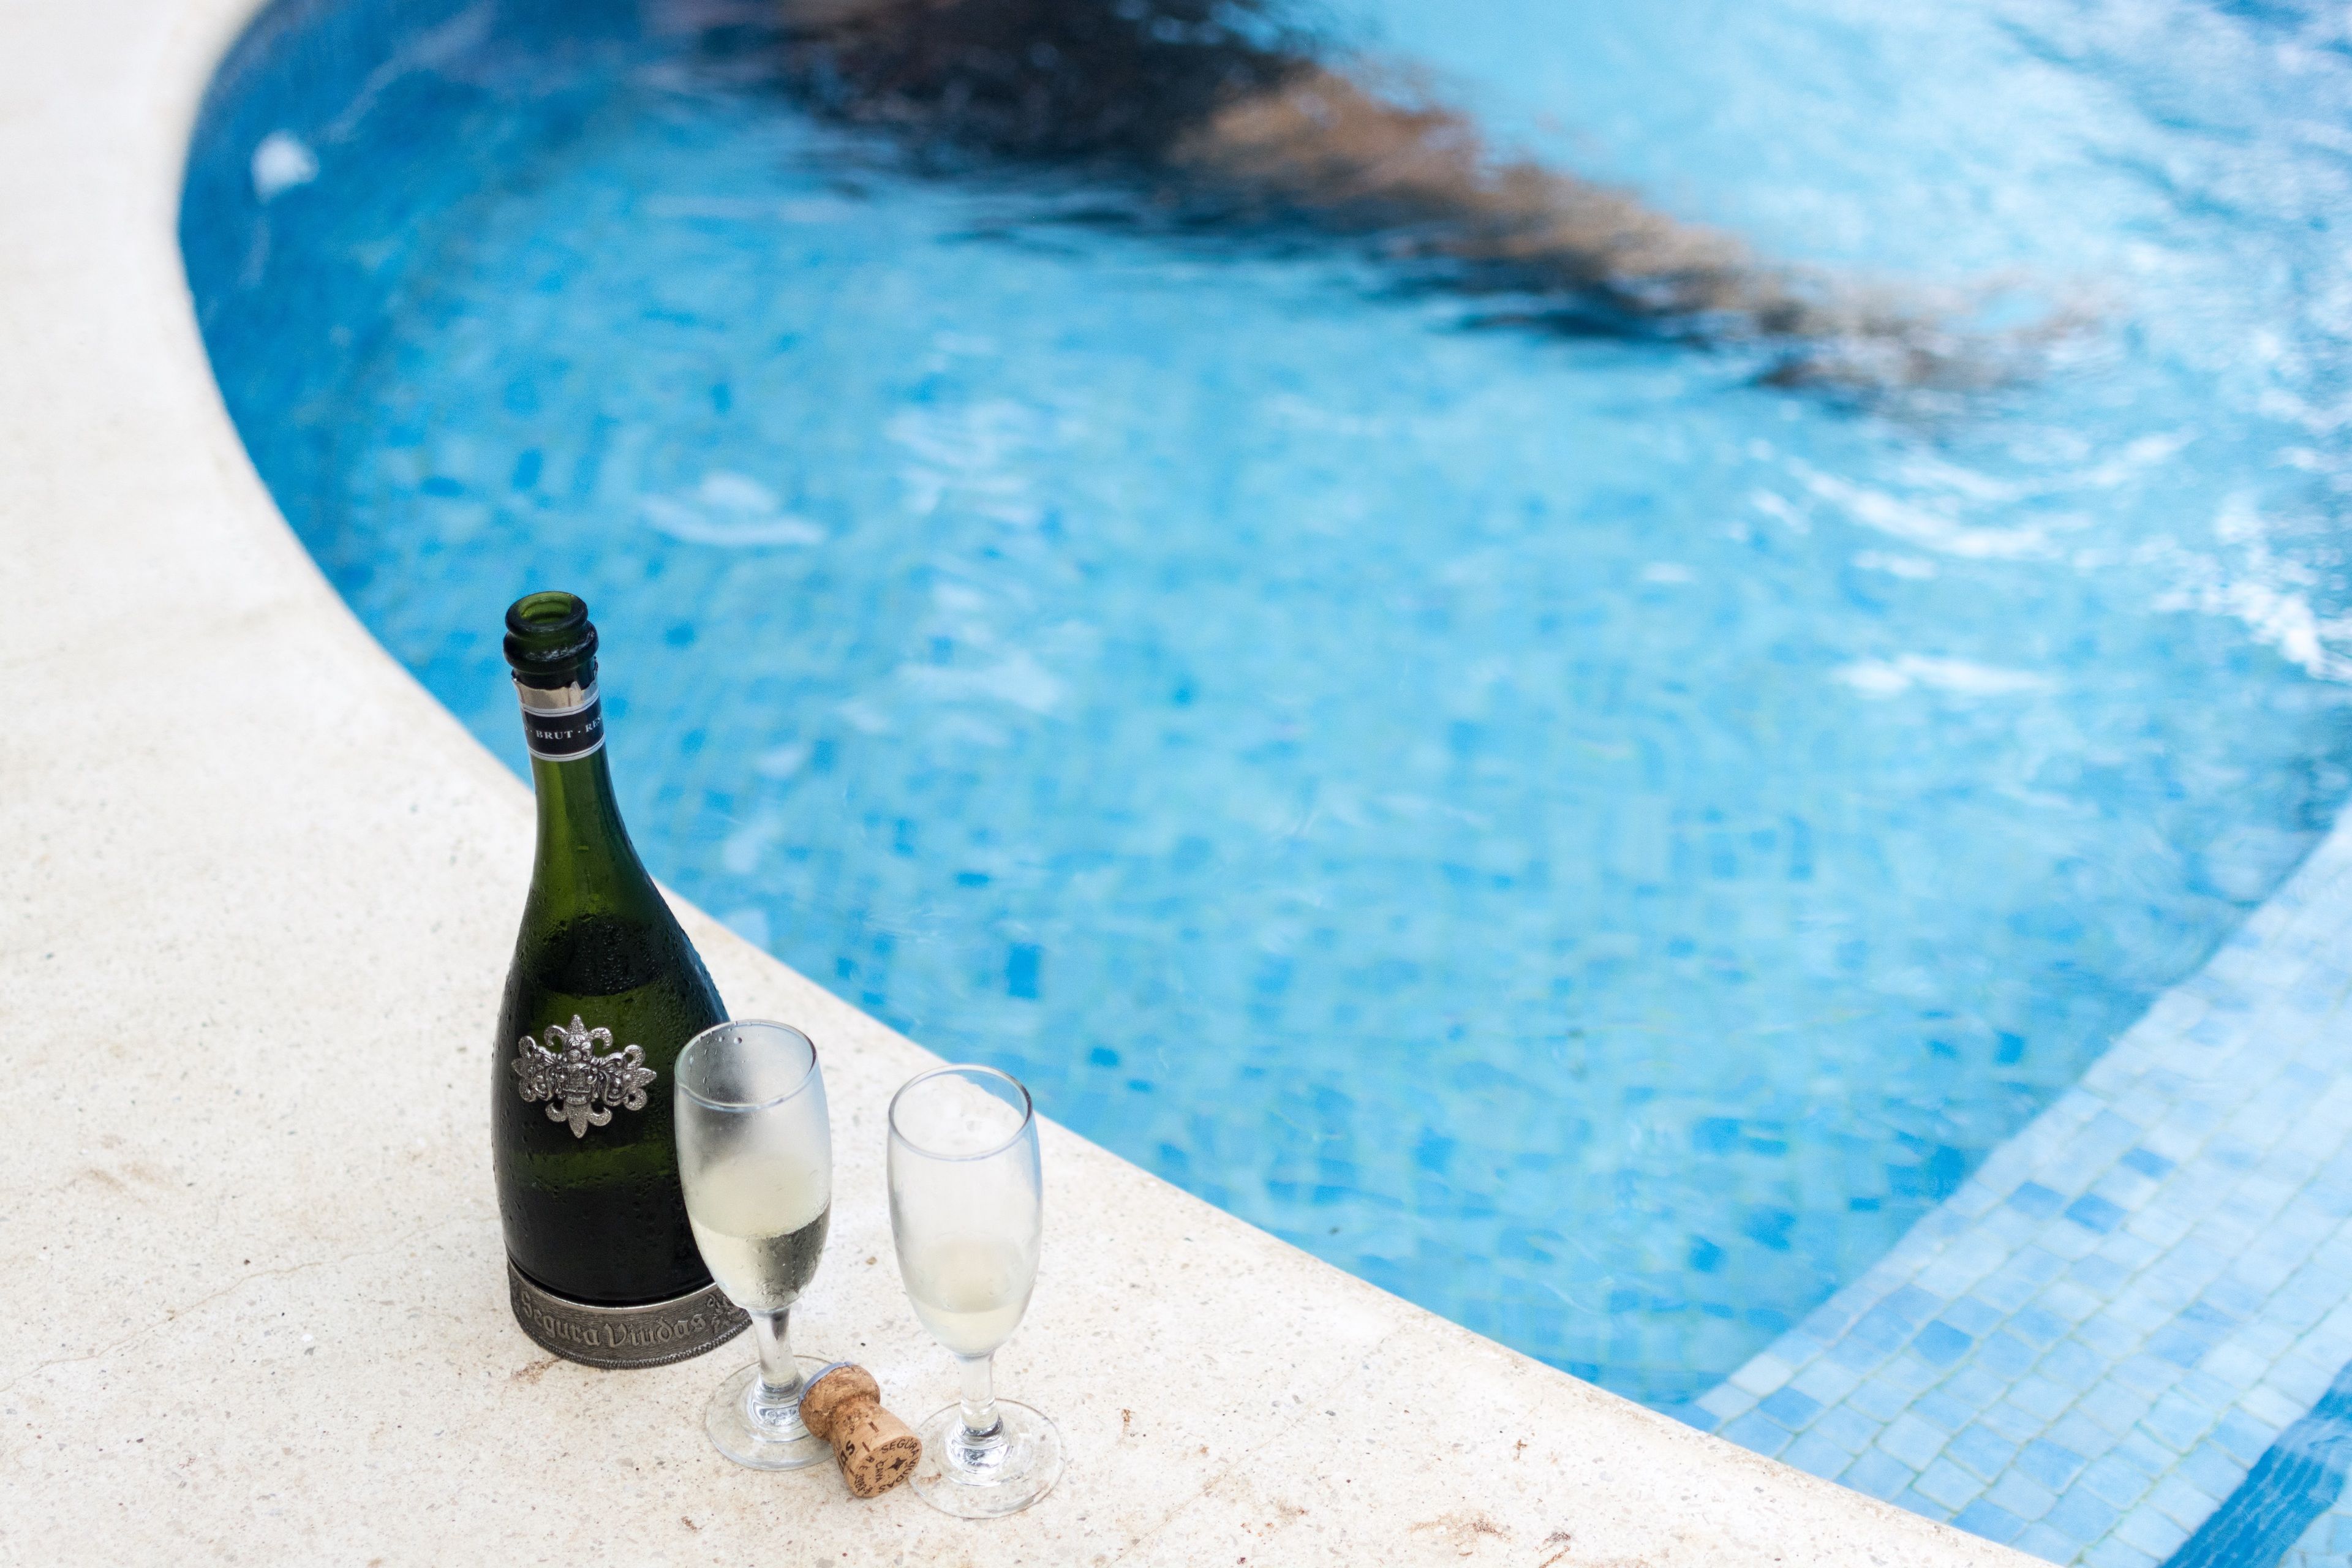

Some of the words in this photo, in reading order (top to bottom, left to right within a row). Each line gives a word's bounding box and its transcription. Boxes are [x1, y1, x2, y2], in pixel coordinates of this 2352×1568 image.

[536, 730, 573, 740] BRUT
[520, 1289, 600, 1347] Segura
[603, 1311, 707, 1349] Viudas
[881, 1438, 920, 1457] SEGURA
[875, 1460, 885, 1483] CAVA
[878, 1457, 918, 1493] VIUDAS
